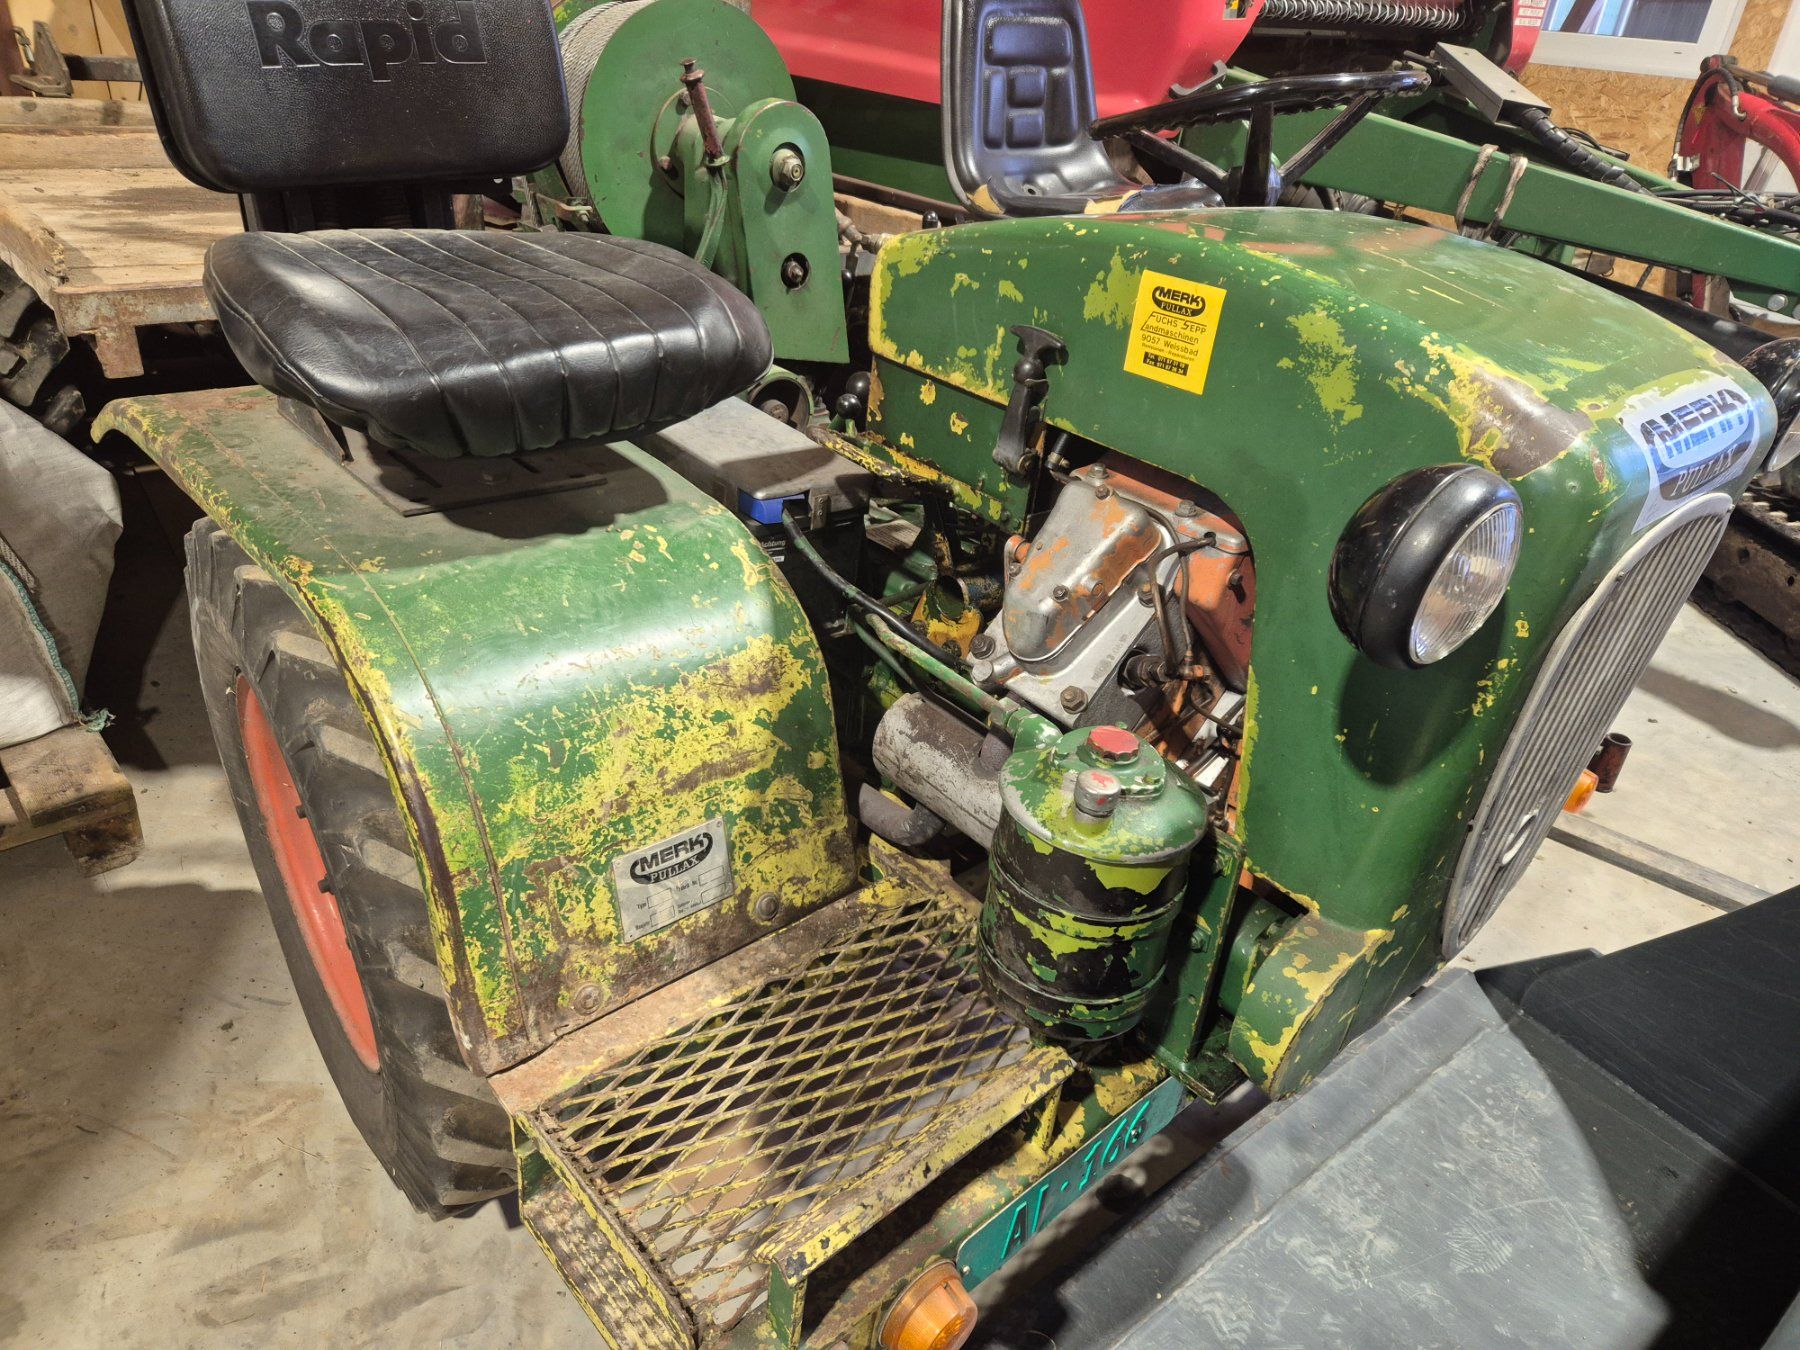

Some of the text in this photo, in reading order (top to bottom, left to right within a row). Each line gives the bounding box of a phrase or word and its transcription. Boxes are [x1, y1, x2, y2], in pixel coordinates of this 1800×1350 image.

[245, 0, 487, 82] Rapid
[1158, 287, 1200, 306] MERK
[1161, 302, 1193, 316] PULLAX
[1148, 312, 1207, 334] FUCHS SEPP
[1142, 334, 1198, 356] 9057 Weissbad
[1670, 444, 1737, 497] PULLAX
[640, 834, 704, 872] MERK
[650, 855, 700, 882] PULLAX
